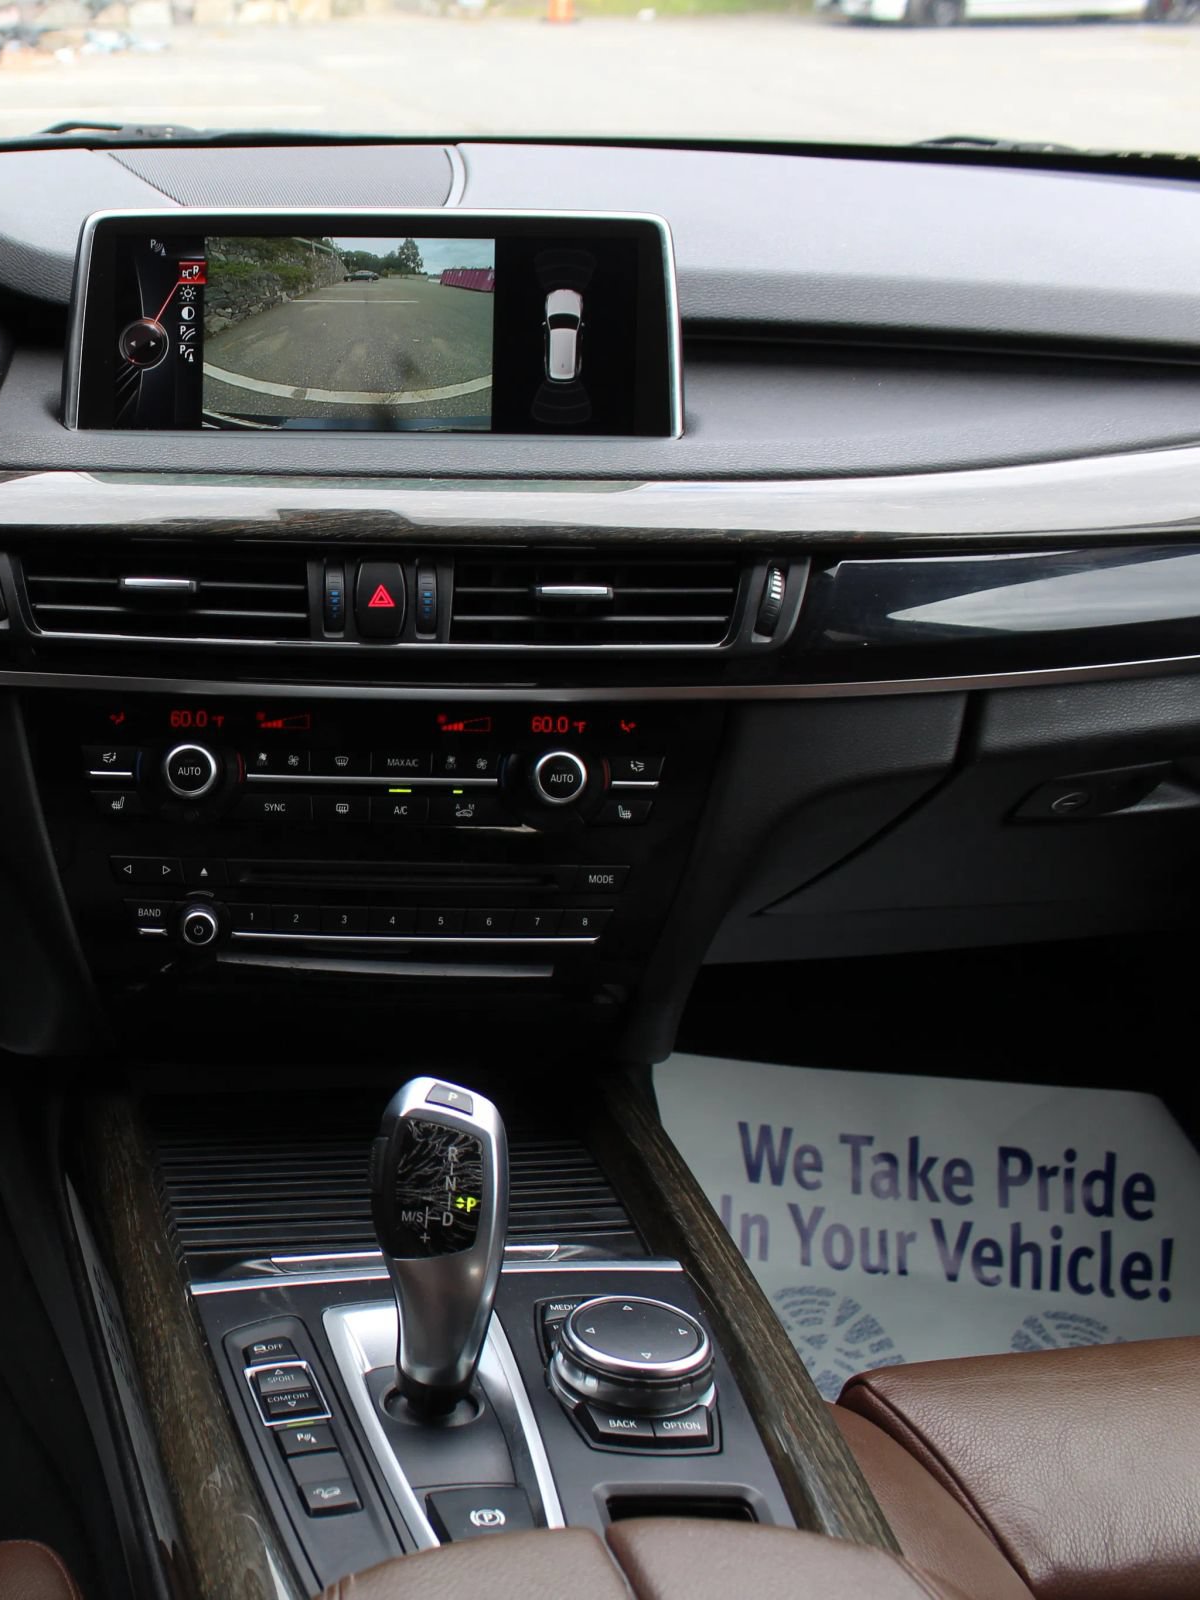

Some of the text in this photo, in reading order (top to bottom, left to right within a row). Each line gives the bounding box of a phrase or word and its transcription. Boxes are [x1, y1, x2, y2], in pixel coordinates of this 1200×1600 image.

[170, 710, 208, 728] 60.0
[531, 716, 569, 733] 60.0
[387, 758, 419, 768] MAX A/C
[177, 766, 201, 776] AUTO
[550, 774, 574, 784] AUTO
[264, 803, 286, 812] SYNC
[394, 806, 408, 816] A/C
[588, 874, 614, 884] MODE
[138, 908, 161, 918] BAND
[250, 912, 588, 926] 1 2 3 4 5 6 7 8
[448, 1092, 458, 1102] P
[448, 1146, 459, 1163] R
[737, 1121, 1156, 1222] We Take Pride
[445, 1176, 456, 1191] N
[466, 1198, 477, 1213] P
[401, 1210, 424, 1223] M/S
[442, 1212, 454, 1227] D
[720, 1194, 1176, 1304] In Your Vehicle!
[267, 1343, 283, 1351] OFF
[267, 1374, 296, 1385] SPORT
[266, 1392, 310, 1403] COMFORT
[608, 1419, 638, 1429] BACK
[662, 1420, 701, 1430] OPTION
